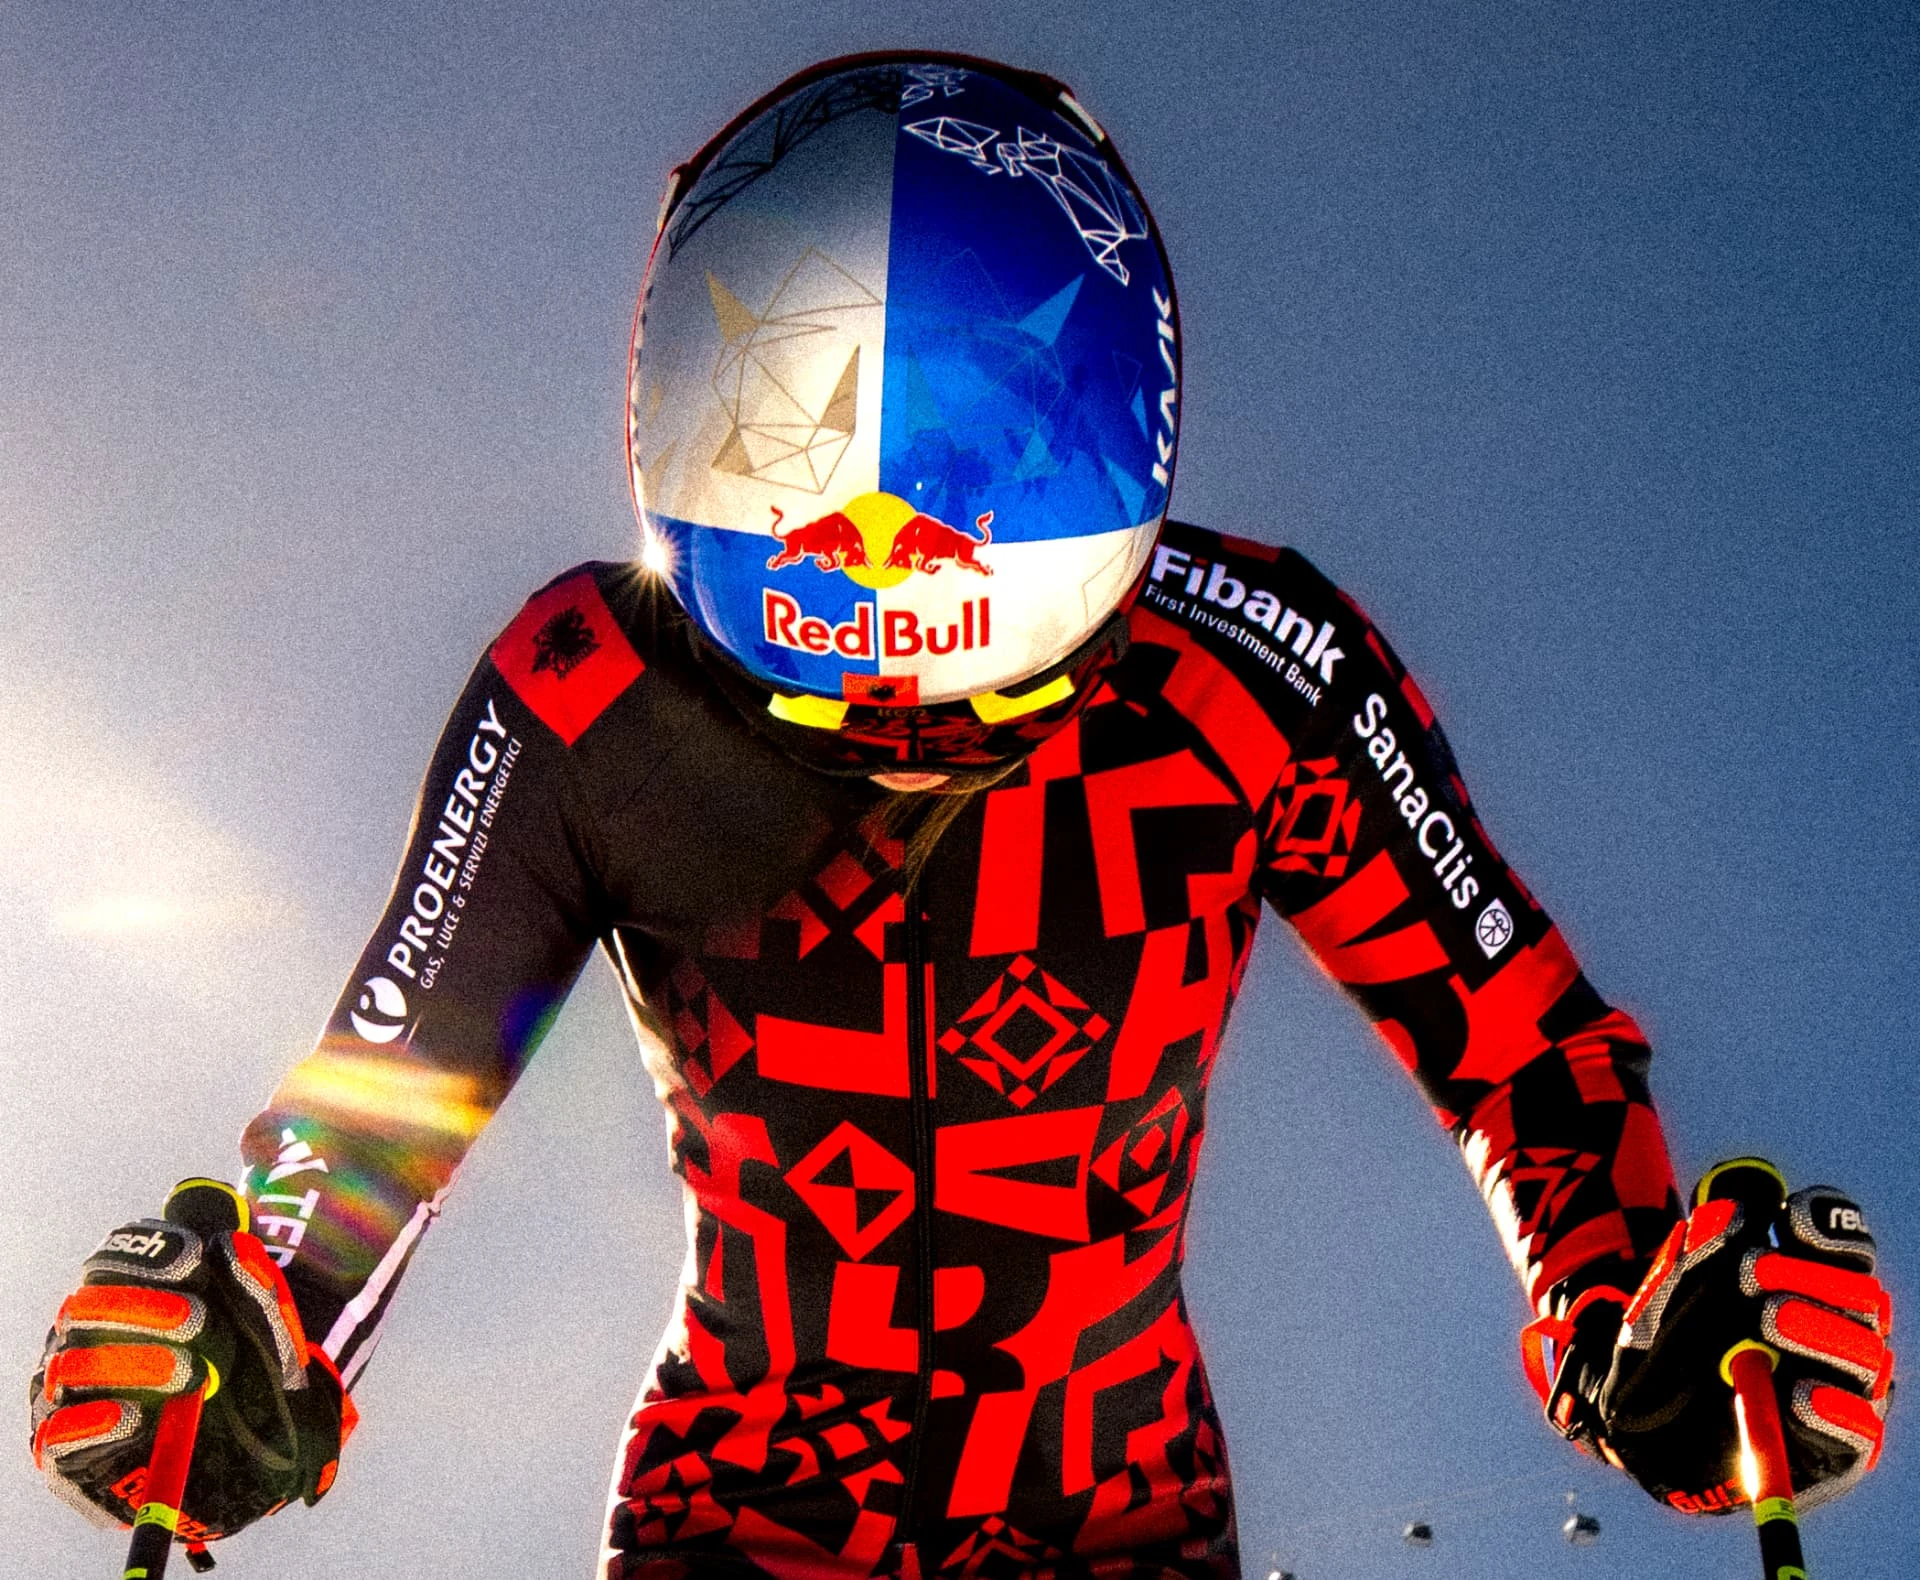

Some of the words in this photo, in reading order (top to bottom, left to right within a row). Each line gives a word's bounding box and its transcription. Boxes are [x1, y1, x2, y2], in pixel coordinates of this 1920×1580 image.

[764, 589, 874, 658] Red
[882, 596, 991, 657] Bull
[1144, 583, 1185, 614] First
[1189, 603, 1284, 673] Investment
[1285, 663, 1323, 707] Bank
[1150, 544, 1346, 686] Fibank
[479, 736, 523, 829] ENERGETICI
[1352, 692, 1480, 910] SanaClis
[386, 698, 508, 980] PROENERGY
[459, 831, 489, 892] SERVIZI
[436, 910, 460, 950] LUCE
[452, 894, 467, 909] &
[419, 955, 446, 990] GAS,
[104, 1230, 167, 1258] sch
